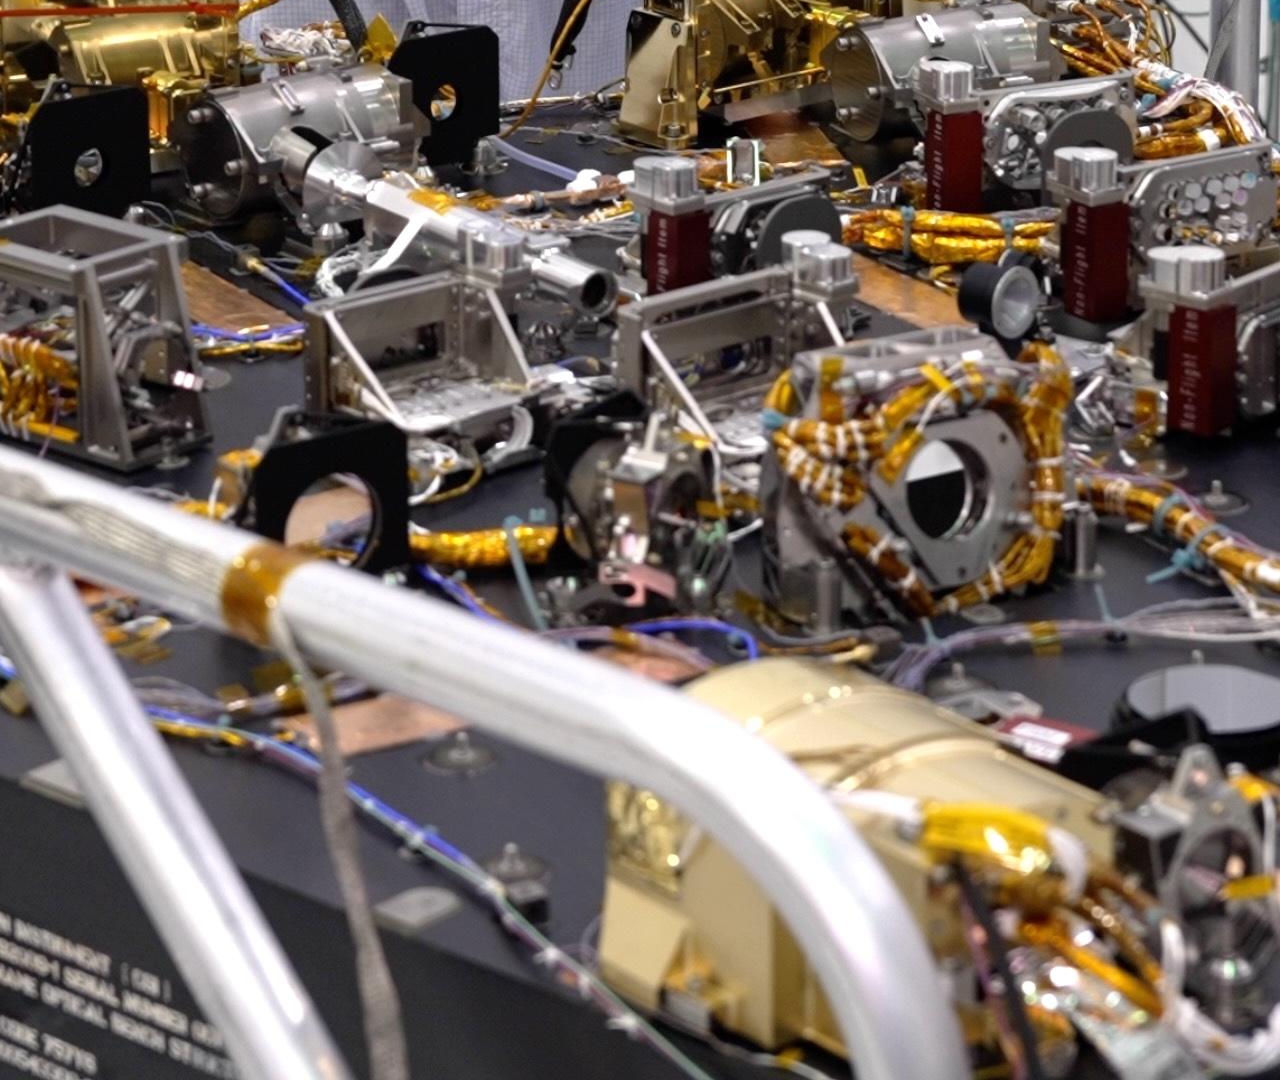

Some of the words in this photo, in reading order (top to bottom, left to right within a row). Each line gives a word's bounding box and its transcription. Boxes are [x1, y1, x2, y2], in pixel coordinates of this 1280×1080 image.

[1073, 245, 1089, 316] Non-Flight
[1180, 353, 1202, 430] Non-Flight
[40, 981, 109, 1029] OPTICAL
[110, 1010, 167, 1055] BENCH
[121, 989, 189, 1037] NUMBER
